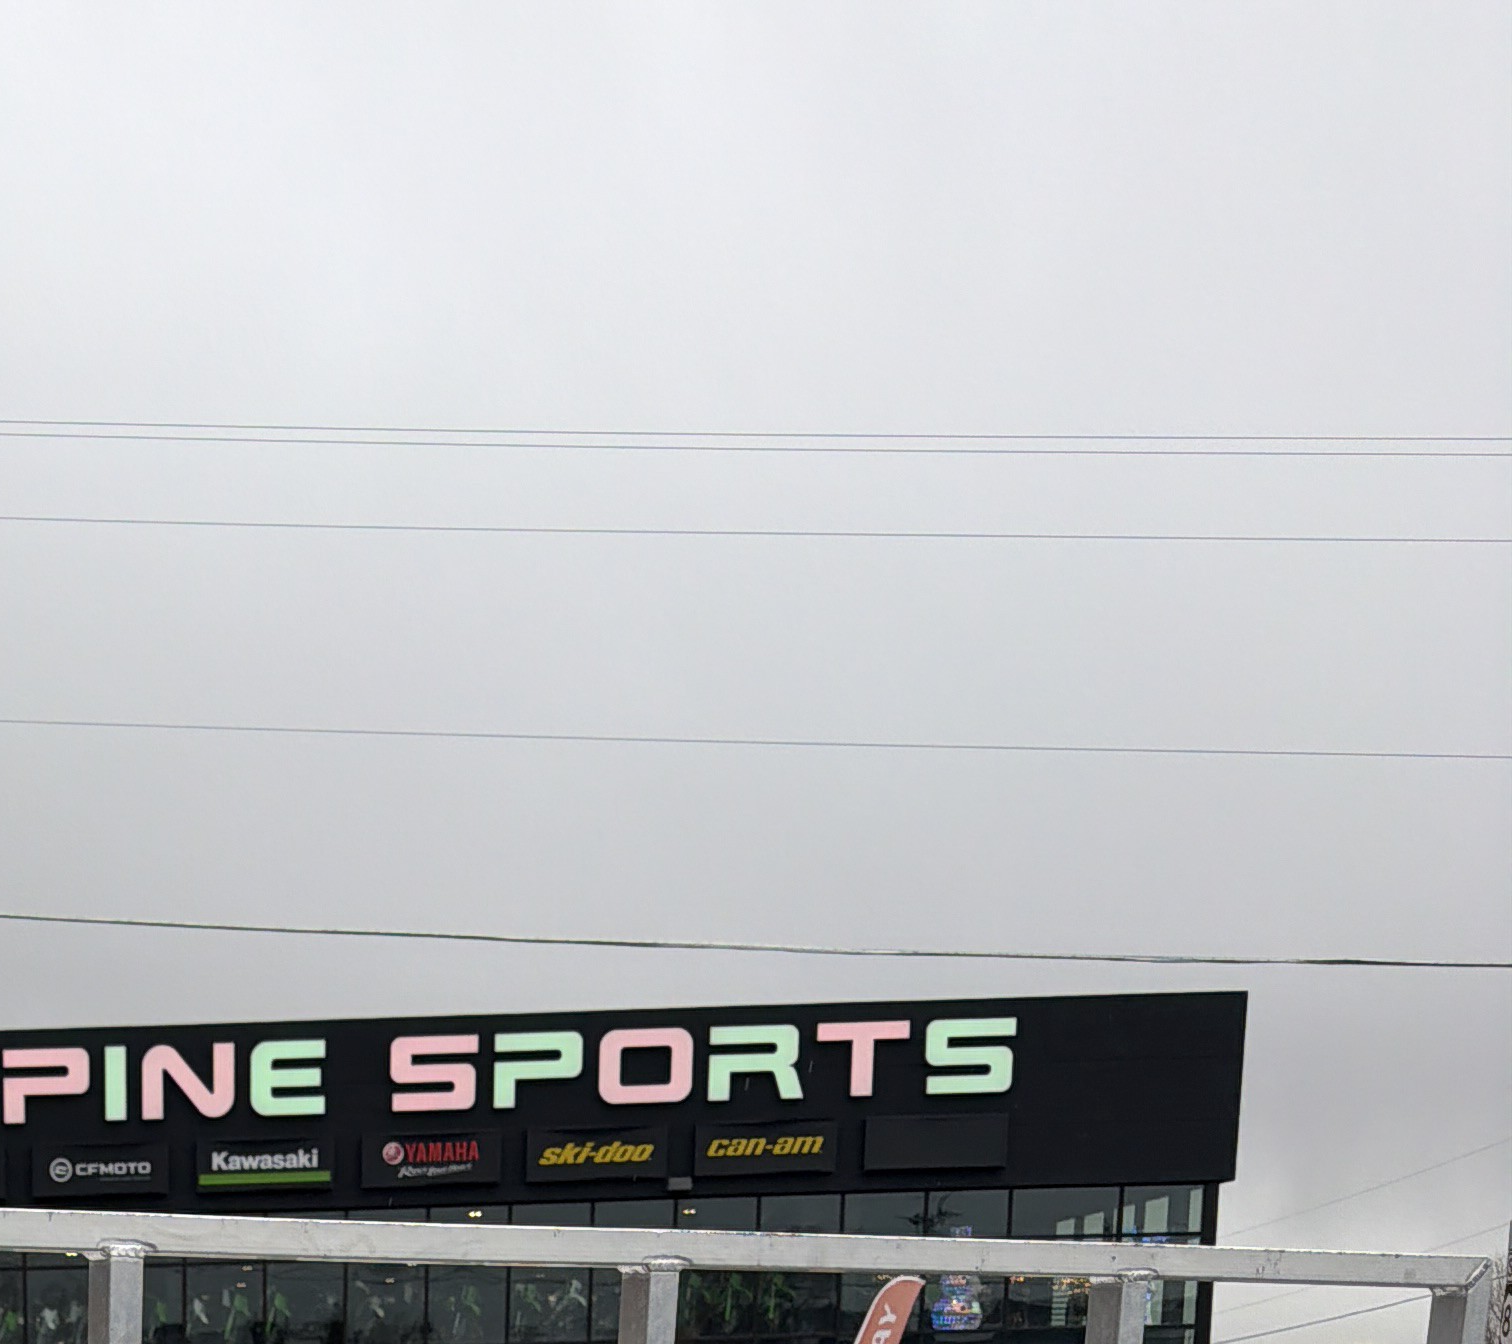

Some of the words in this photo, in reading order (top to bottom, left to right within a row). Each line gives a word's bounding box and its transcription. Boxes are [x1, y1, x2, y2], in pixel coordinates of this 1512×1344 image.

[2, 1039, 326, 1124] PINE
[389, 1017, 1018, 1112] SPORTS
[405, 1140, 480, 1163] YAMAHA
[538, 1141, 655, 1166] ski-doo
[706, 1135, 824, 1158] can-am
[75, 1160, 152, 1176] CFMOTO
[211, 1148, 319, 1171] Kawasaki
